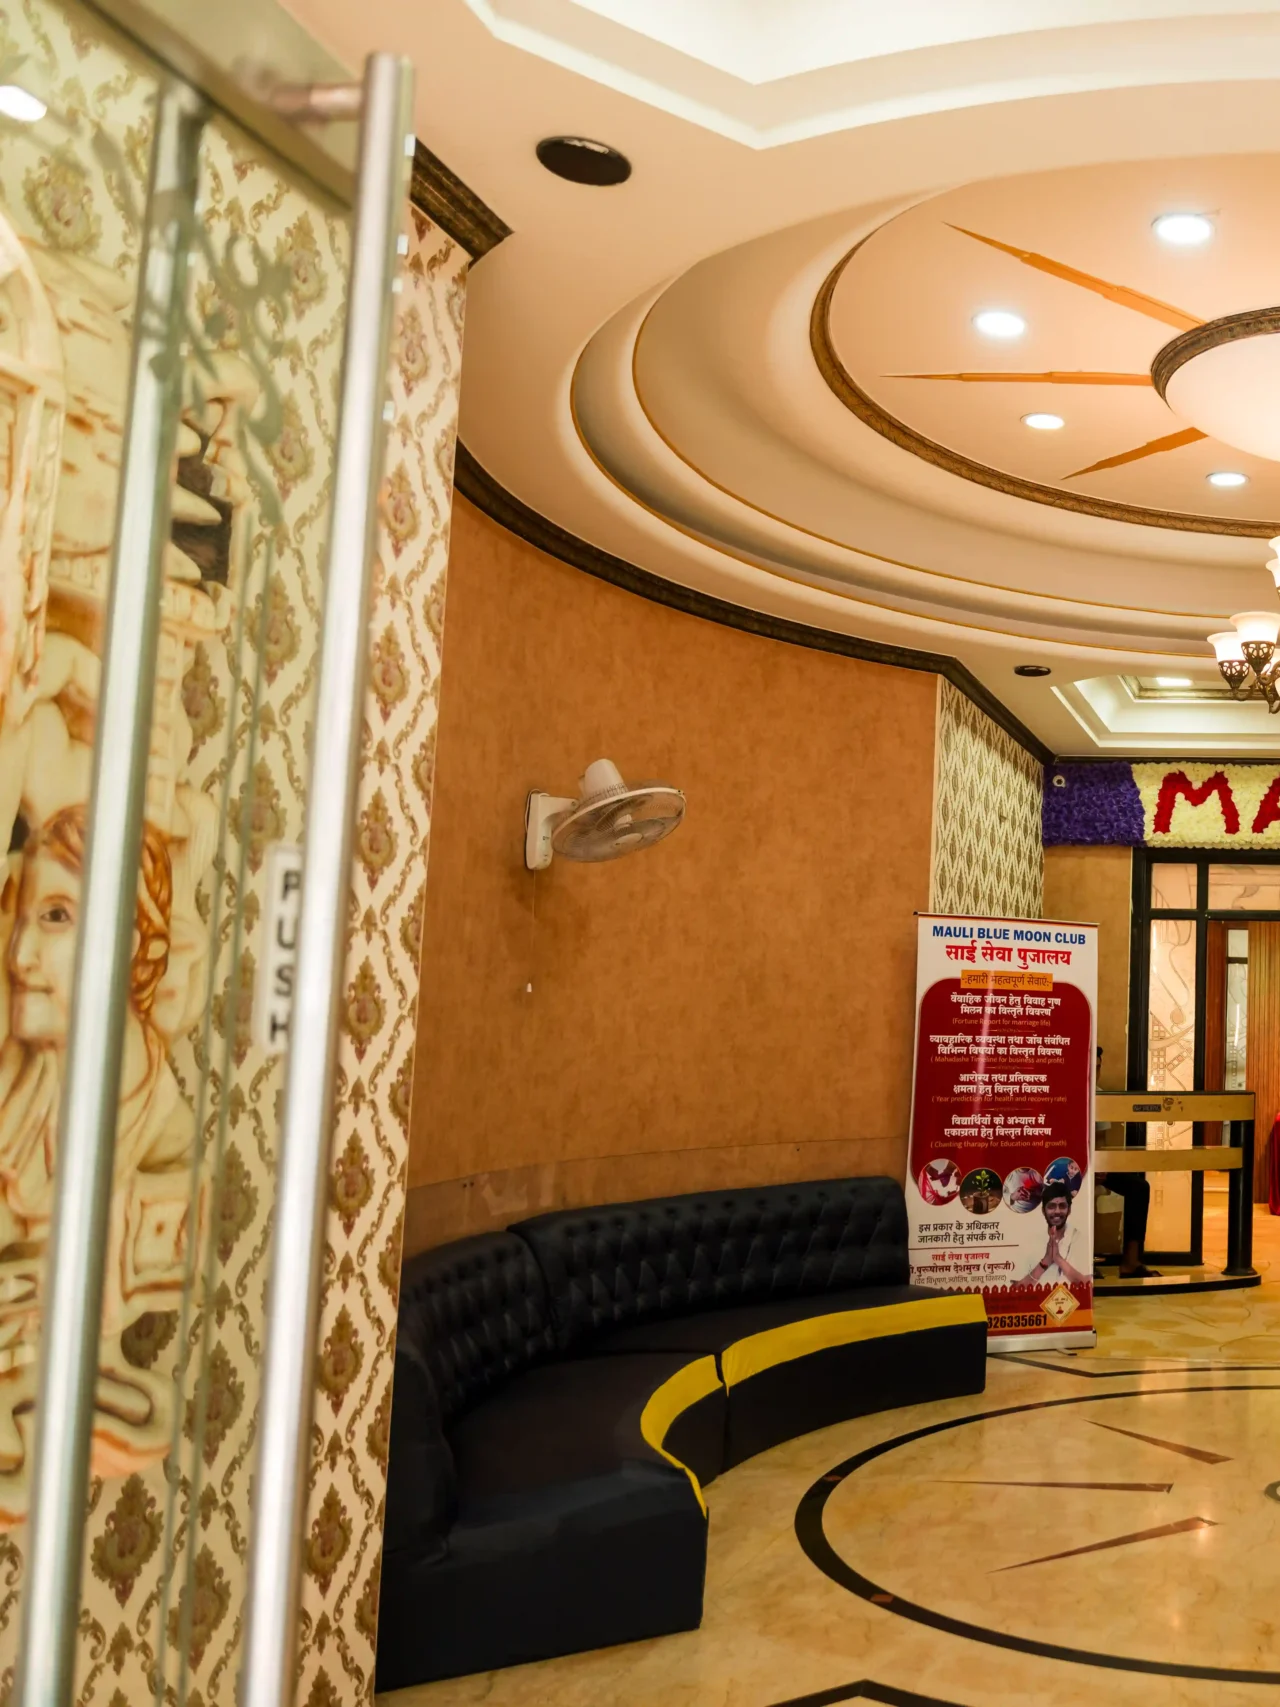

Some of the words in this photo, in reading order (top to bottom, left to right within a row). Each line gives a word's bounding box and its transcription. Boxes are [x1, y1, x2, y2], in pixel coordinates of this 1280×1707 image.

[932, 925, 973, 938] MAULI
[977, 927, 1010, 940] BLUE
[1013, 930, 1051, 942] MOON
[1054, 933, 1086, 944] CLUB
[270, 869, 301, 1043] PUSH
[945, 940, 977, 963] साई
[981, 941, 1013, 962] सेवा
[1017, 948, 1072, 970] पुजालय
[1012, 1019, 1039, 1028] marriage
[919, 1224, 931, 1233] इस
[933, 1222, 953, 1232] प्रकार
[956, 1220, 963, 1230] के
[966, 1220, 1000, 1230] अधिकतर
[918, 1232, 950, 1244] जानकारी
[953, 1232, 964, 1245] हेतु
[966, 1231, 987, 1242] संपर्क
